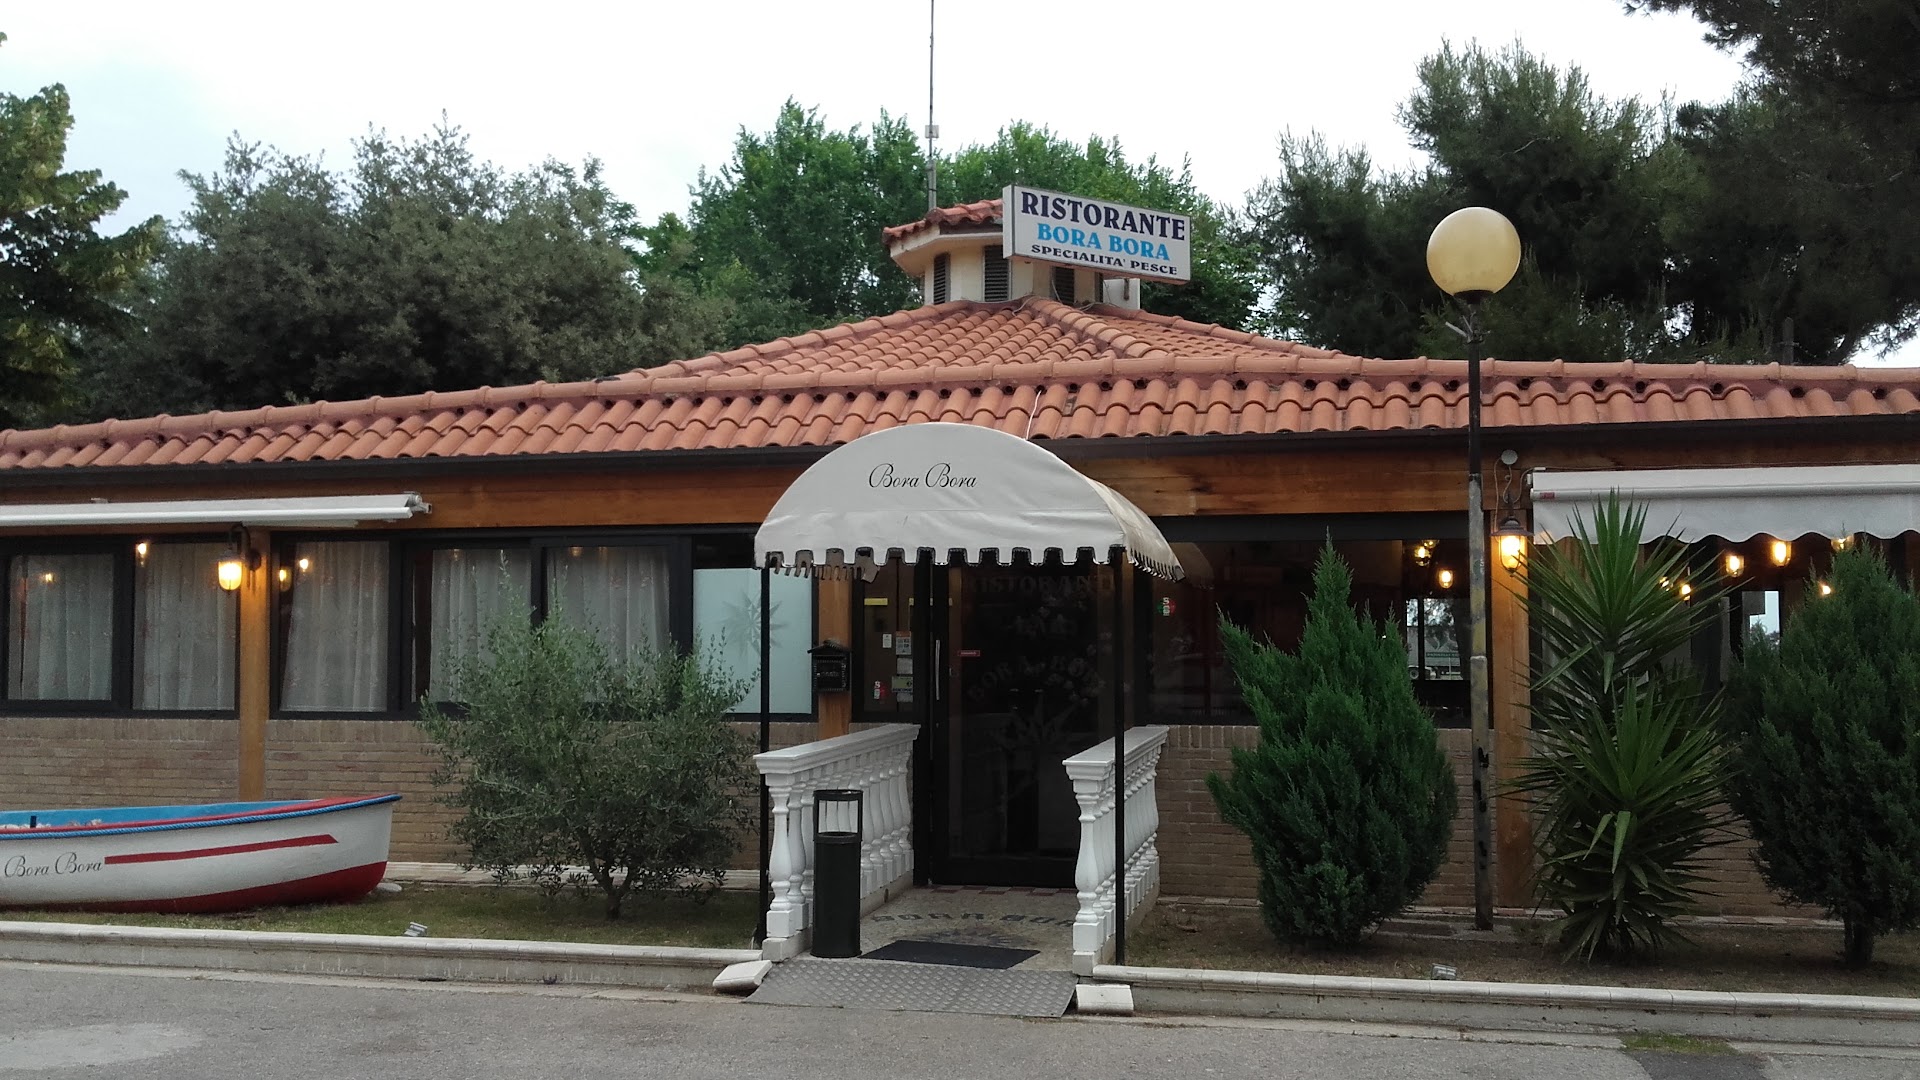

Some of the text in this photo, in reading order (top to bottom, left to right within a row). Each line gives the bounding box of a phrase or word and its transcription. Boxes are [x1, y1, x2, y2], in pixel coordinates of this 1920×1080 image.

[1020, 191, 1185, 241] RISTORANTE
[1037, 222, 1171, 261] BORA BORA
[1031, 244, 1178, 276] SPECIALITA' PESCE
[868, 462, 978, 488] Bora Bora
[4, 851, 103, 878] Bora Bora
